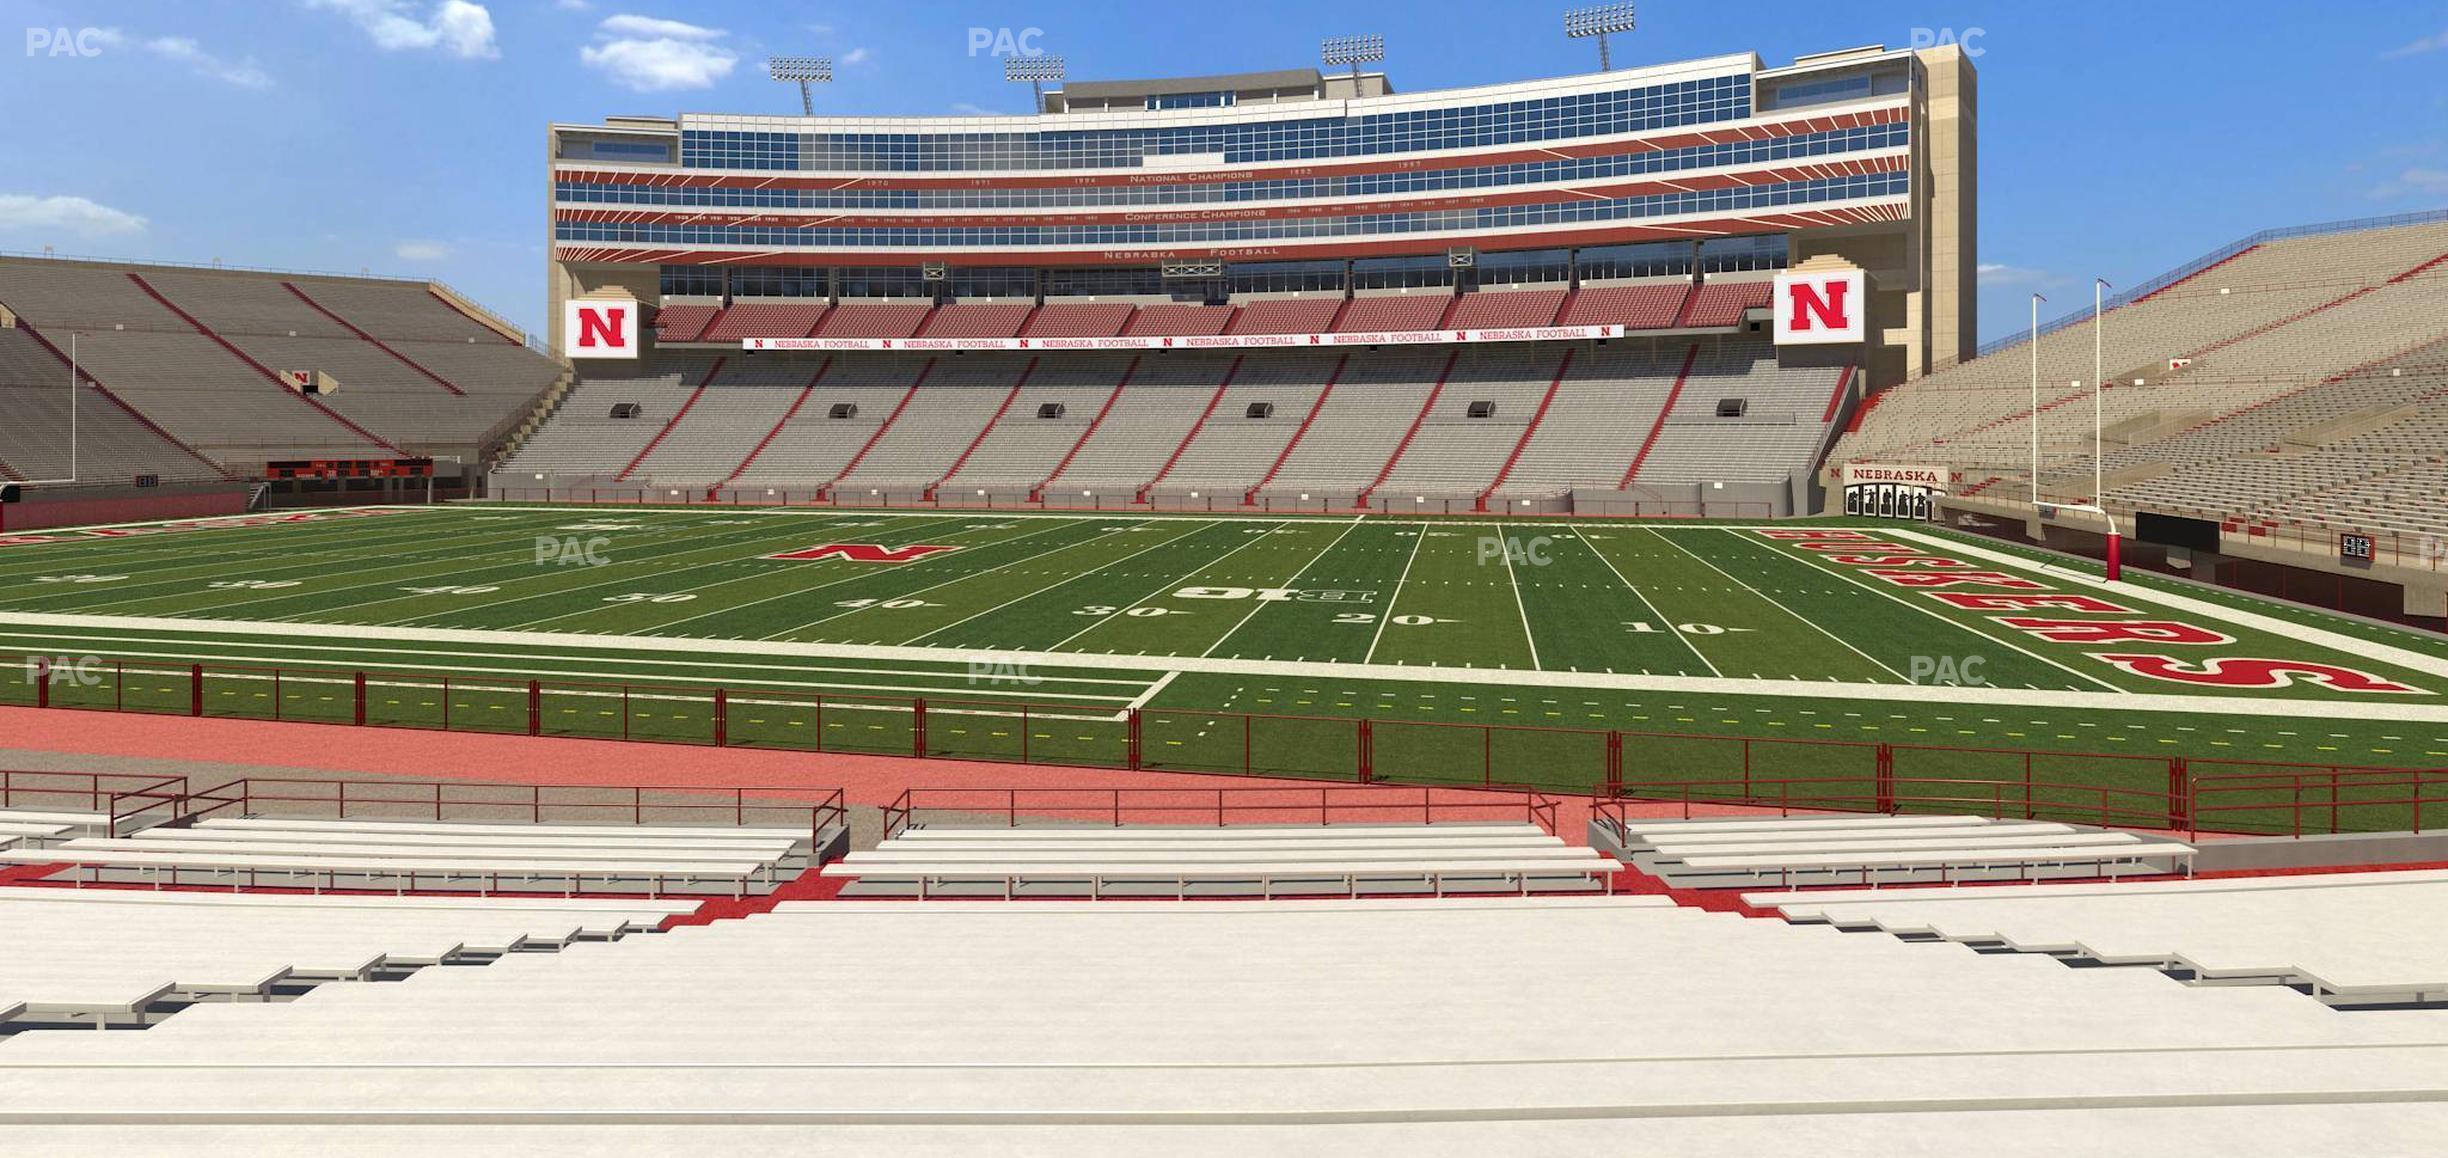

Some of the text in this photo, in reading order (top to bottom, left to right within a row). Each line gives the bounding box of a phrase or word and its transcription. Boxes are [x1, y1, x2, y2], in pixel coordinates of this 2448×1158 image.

[1790, 281, 1847, 331] N
[579, 308, 625, 347] N
[775, 340, 820, 348] NEBRASKA
[824, 340, 870, 348] FOOTBALL
[904, 340, 952, 348] NEBRASKA
[957, 340, 1006, 348] FOOTBALL
[1042, 339, 1093, 348] NEBRASKA
[1098, 339, 1149, 347] FOOTBALL
[1187, 338, 1239, 346] NEBRASKA
[1244, 337, 1296, 345] FOOTBALL
[1333, 335, 1386, 343] NEBRASKA
[1390, 333, 1442, 342] FOOTBALL
[1479, 330, 1531, 339] NEBRASKA
[1536, 328, 1587, 338] FOOTBALL
[1853, 468, 1938, 482] NEBRASKA
[1072, 605, 1169, 617] 30
[1330, 612, 1435, 626] 20
[1752, 528, 2443, 695] HUSKERS
[1620, 621, 1726, 635] 10
